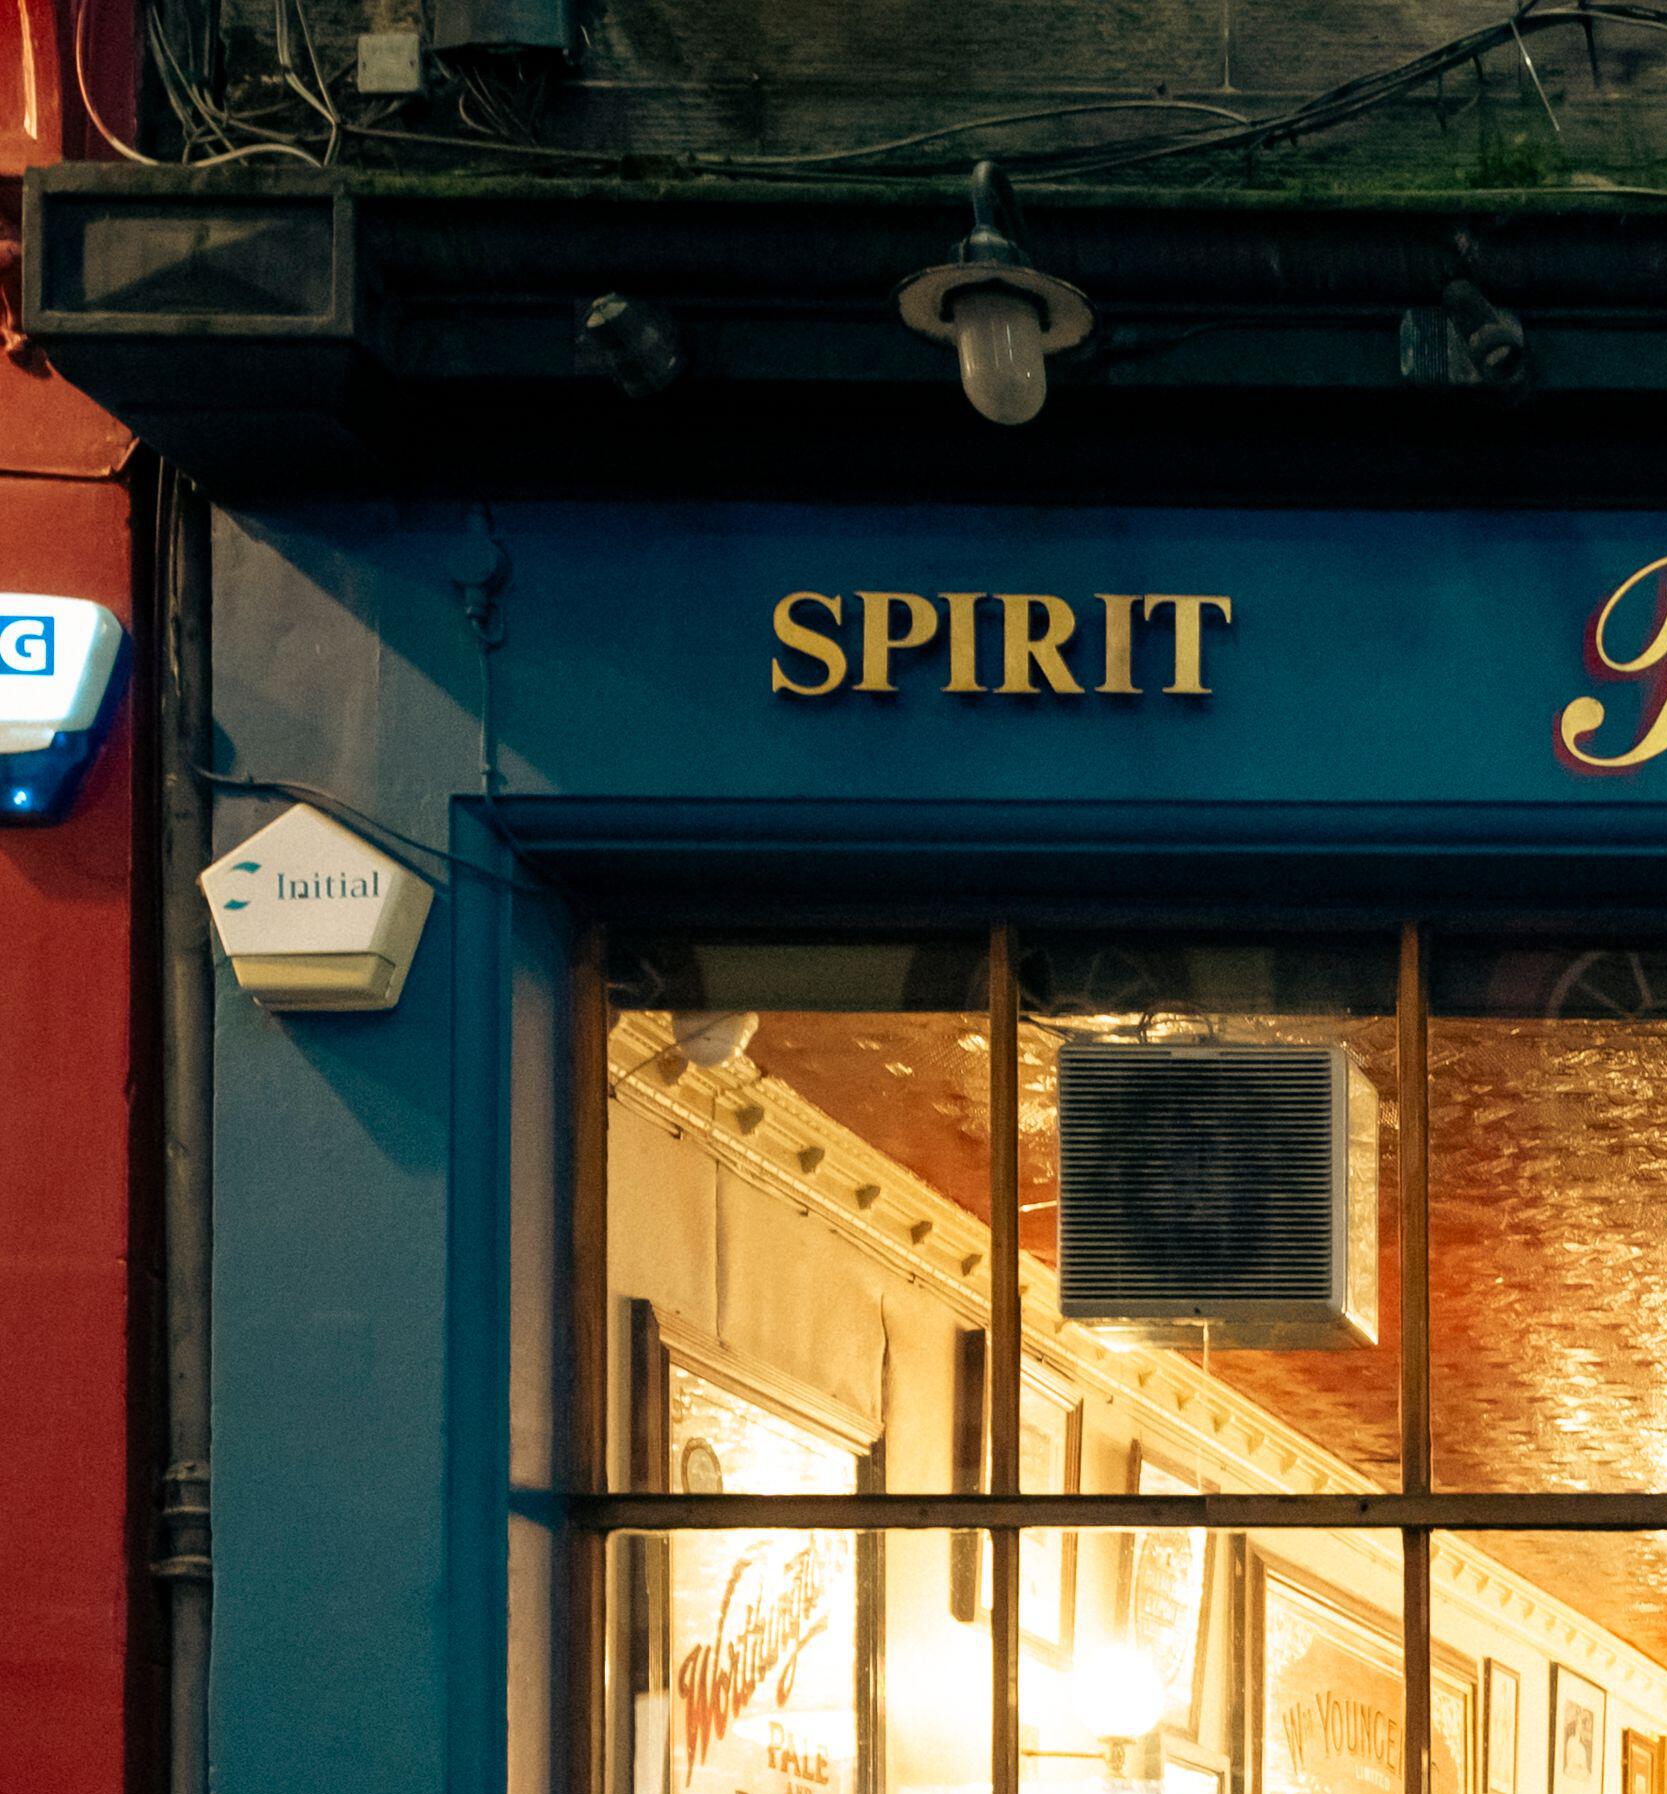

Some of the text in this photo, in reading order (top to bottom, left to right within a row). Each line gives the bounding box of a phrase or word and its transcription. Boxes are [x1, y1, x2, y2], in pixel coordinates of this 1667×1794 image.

[772, 591, 1231, 698] SPIRIT
[275, 870, 381, 902] Initial
[767, 1720, 829, 1786] PALE
[1316, 1690, 1404, 1781] YOUNGE
